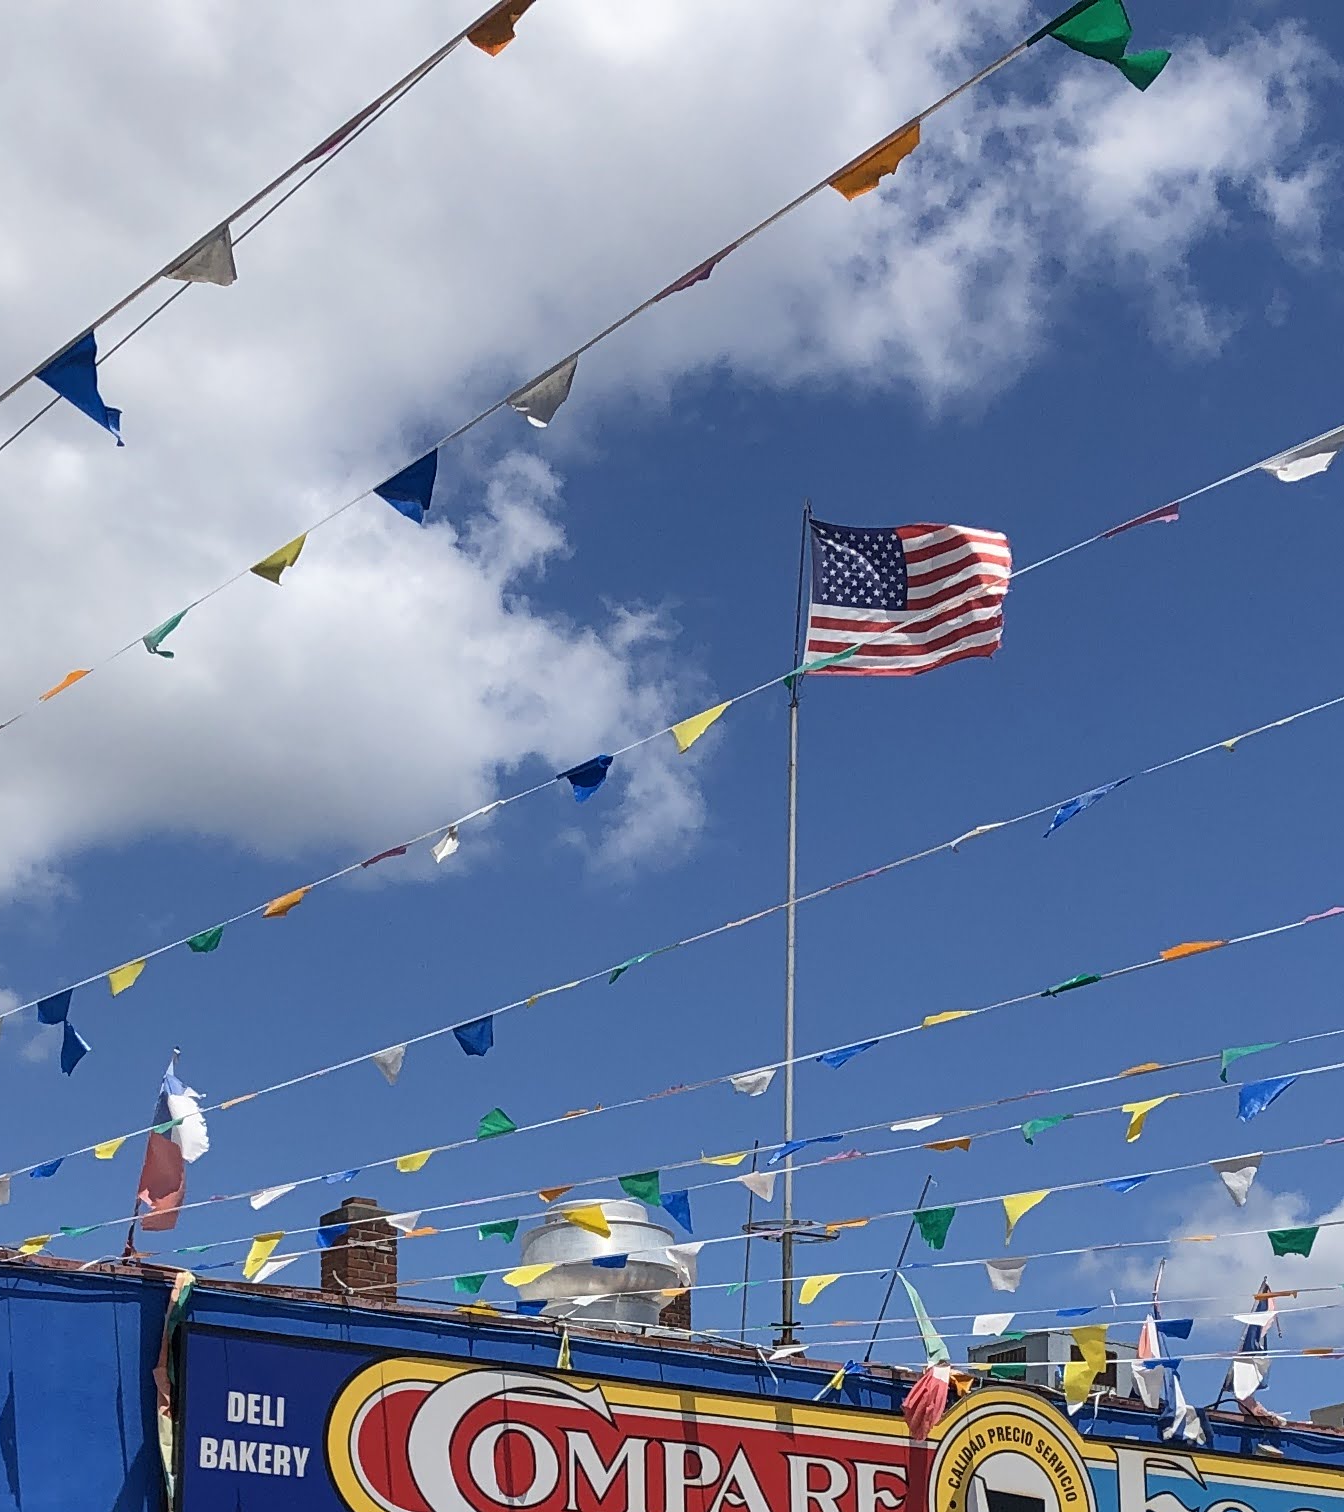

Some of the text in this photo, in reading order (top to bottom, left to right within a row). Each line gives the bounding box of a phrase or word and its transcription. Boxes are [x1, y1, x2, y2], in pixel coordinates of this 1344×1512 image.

[227, 1391, 285, 1427] DELI
[199, 1437, 310, 1478] BAKERY
[948, 1426, 1077, 1502] CALIDAD PRECIO SERVICIO
